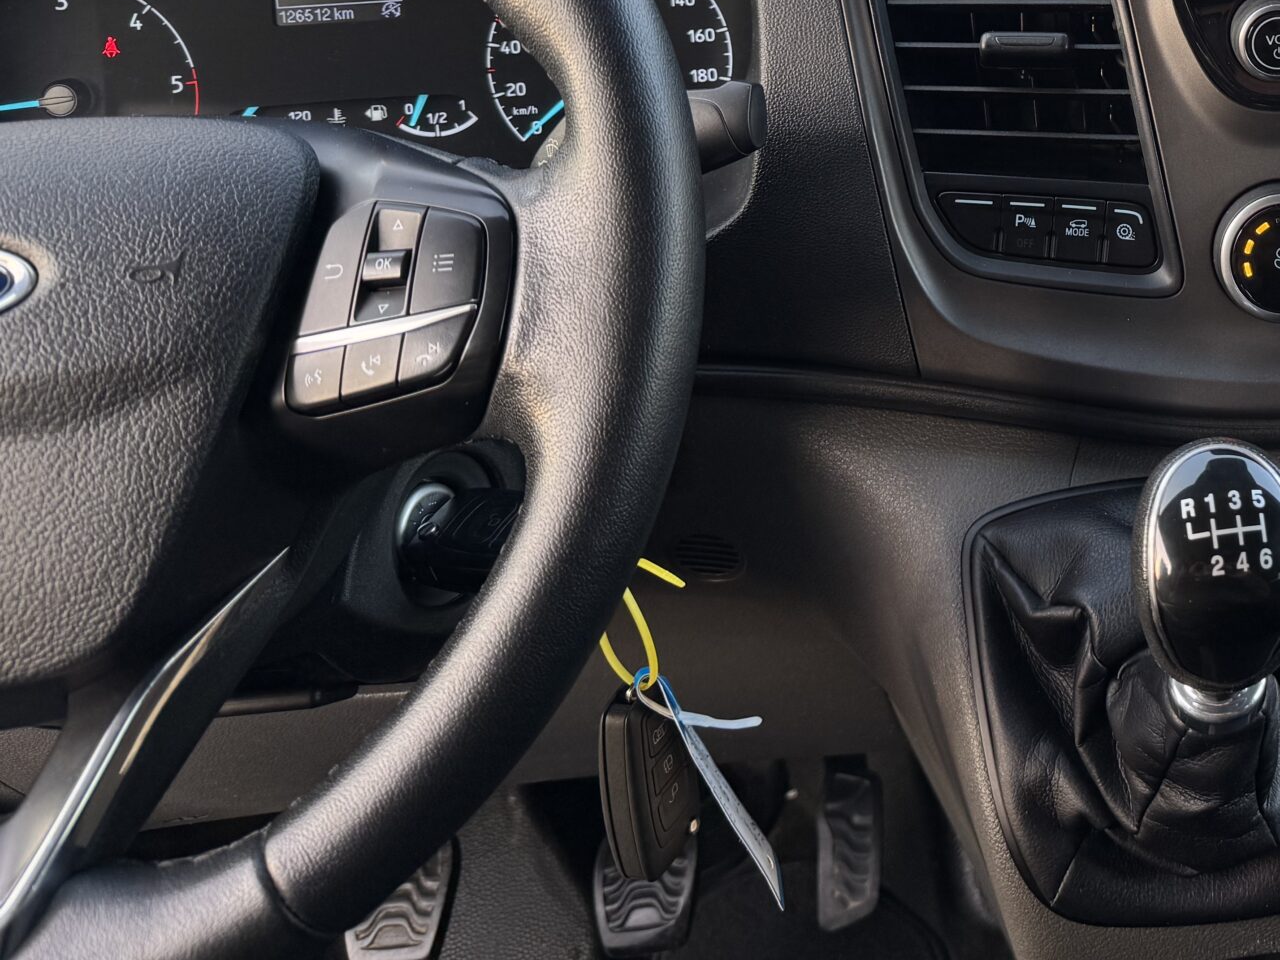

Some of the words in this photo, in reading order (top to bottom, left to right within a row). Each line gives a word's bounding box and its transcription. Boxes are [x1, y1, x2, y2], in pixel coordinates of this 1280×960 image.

[129, 13, 143, 30] 4
[280, 8, 331, 23] 126512
[334, 7, 354, 20] km
[687, 28, 716, 42] 160
[500, 40, 521, 54] 40
[690, 68, 718, 83] 180
[170, 75, 184, 93] 5
[505, 82, 527, 97] 20
[404, 103, 414, 116] 0
[458, 99, 466, 112] 1
[512, 105, 539, 117] km/h
[427, 111, 448, 125] 1/2
[1065, 227, 1089, 237] MODE
[375, 257, 392, 270] OK
[1180, 498, 1196, 519] R
[1203, 493, 1216, 513] 1
[1227, 490, 1242, 510] 3
[1251, 490, 1266, 508] 5
[1210, 555, 1226, 577] 2
[1236, 552, 1250, 572] 4
[1259, 548, 1273, 569] 6
